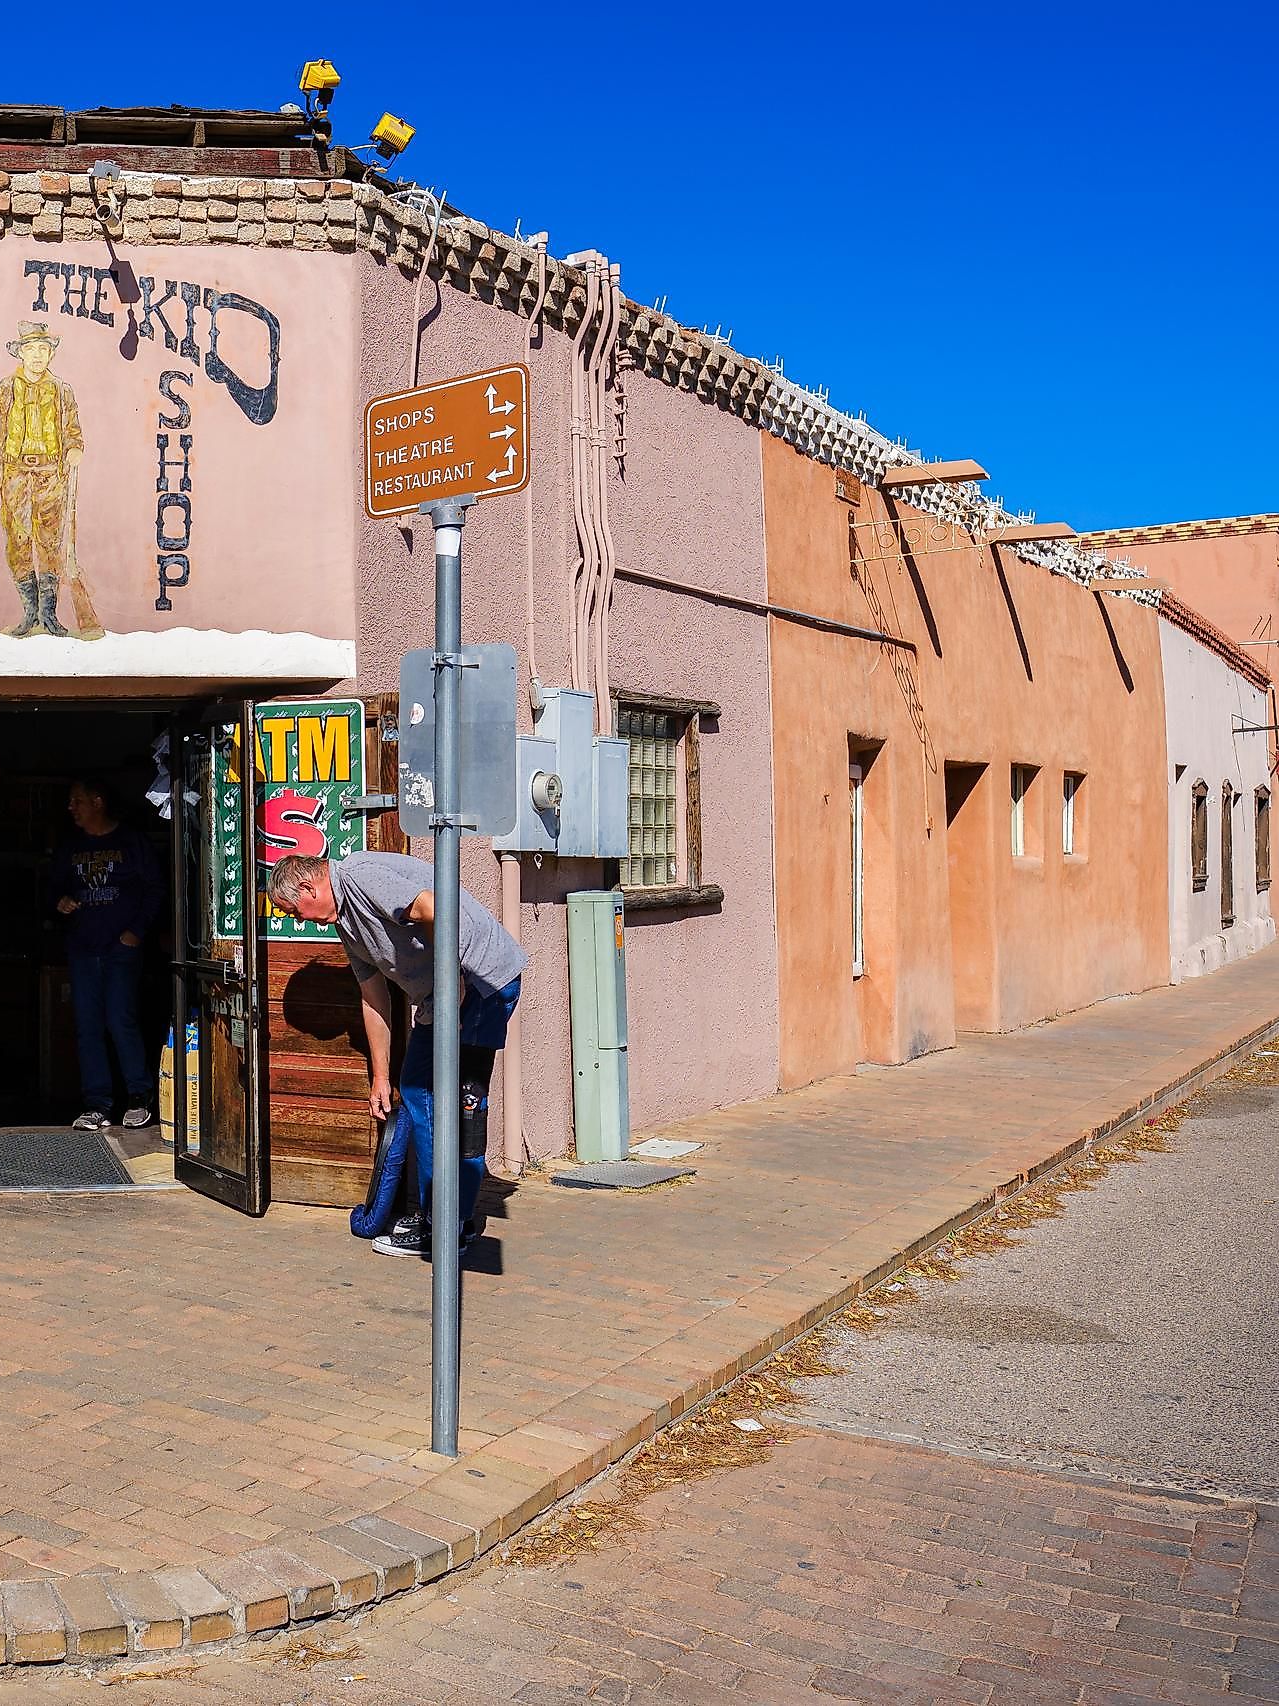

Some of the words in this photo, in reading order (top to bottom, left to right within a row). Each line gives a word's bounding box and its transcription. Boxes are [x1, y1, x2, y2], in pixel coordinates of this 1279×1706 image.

[24, 259, 116, 326] THE
[138, 275, 280, 425] KID
[374, 406, 435, 436] SHOPS
[374, 436, 454, 468] THEATRE
[155, 370, 193, 611] SHOP
[374, 462, 475, 497] RESTAURANT
[226, 714, 351, 783] ATM
